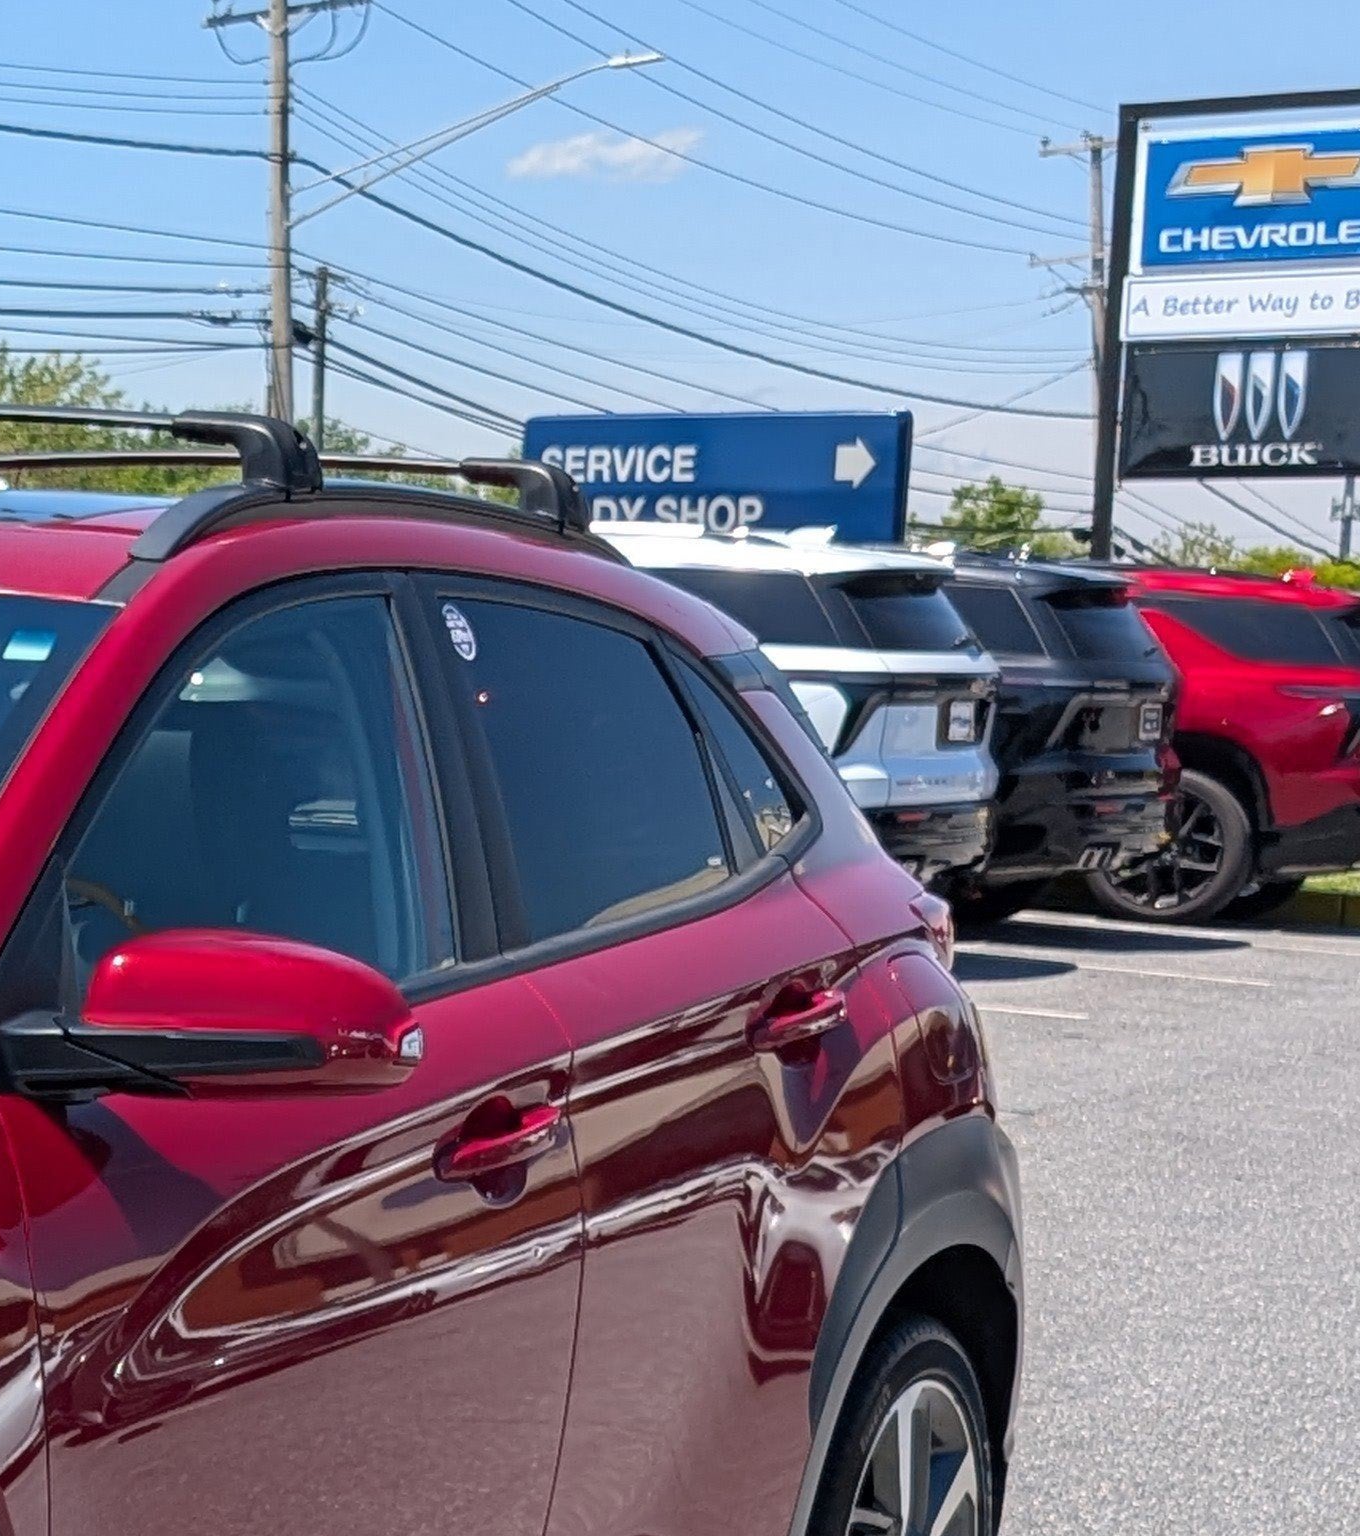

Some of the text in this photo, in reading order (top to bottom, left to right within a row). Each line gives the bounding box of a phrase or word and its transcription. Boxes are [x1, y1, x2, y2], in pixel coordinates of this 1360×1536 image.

[1132, 298, 1150, 317] A
[1162, 295, 1239, 317] Better
[1249, 293, 1299, 318] Way
[1310, 289, 1333, 310] to
[540, 445, 698, 483] SERVICE
[1189, 443, 1318, 467] BUICK
[592, 496, 764, 532] DY SHOP
